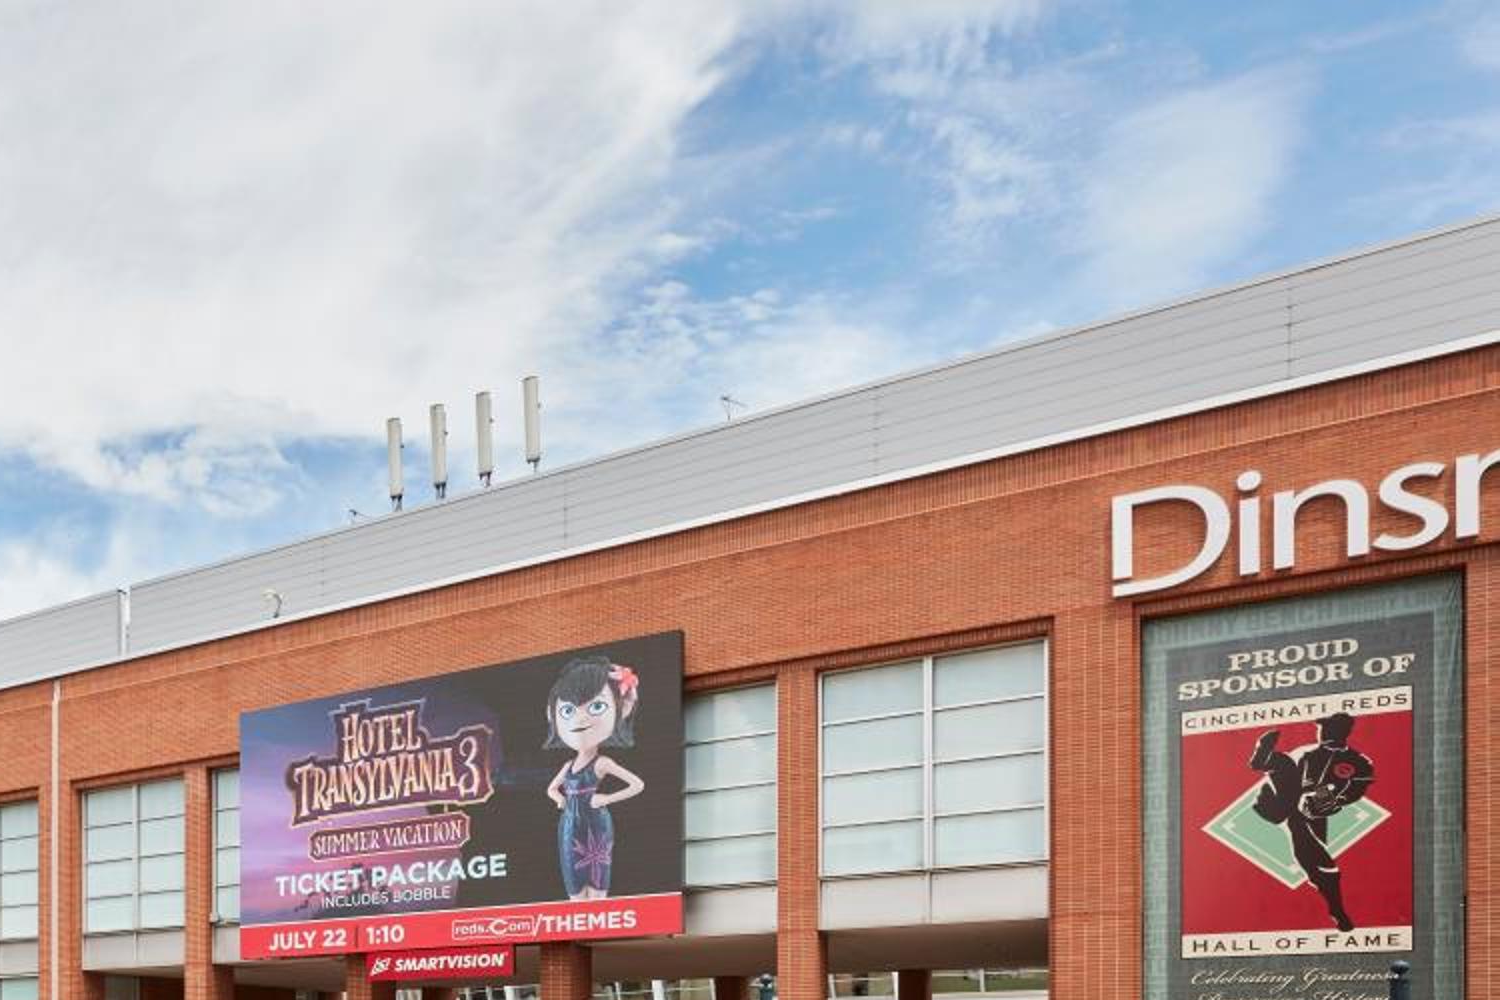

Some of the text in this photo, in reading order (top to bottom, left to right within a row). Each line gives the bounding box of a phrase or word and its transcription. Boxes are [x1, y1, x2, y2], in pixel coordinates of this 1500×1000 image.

[1228, 637, 1359, 672] PROUD
[1178, 653, 1416, 702] SPONSOR OF
[1184, 692, 1409, 730] CINCINNATI REDS
[341, 710, 422, 763] HOTEL
[293, 735, 481, 818] TRANSYLVANIA 3
[313, 819, 463, 857] SUMMER VACATION
[275, 853, 509, 897] TICKET PACKAGE
[320, 885, 452, 909] INCLUDES BOBBLE
[269, 931, 318, 952] JULY
[321, 928, 348, 949] 22
[366, 925, 405, 946] 1:10
[1192, 932, 1402, 954] HALL OF FAME
[395, 952, 505, 972] SMARTVISION
